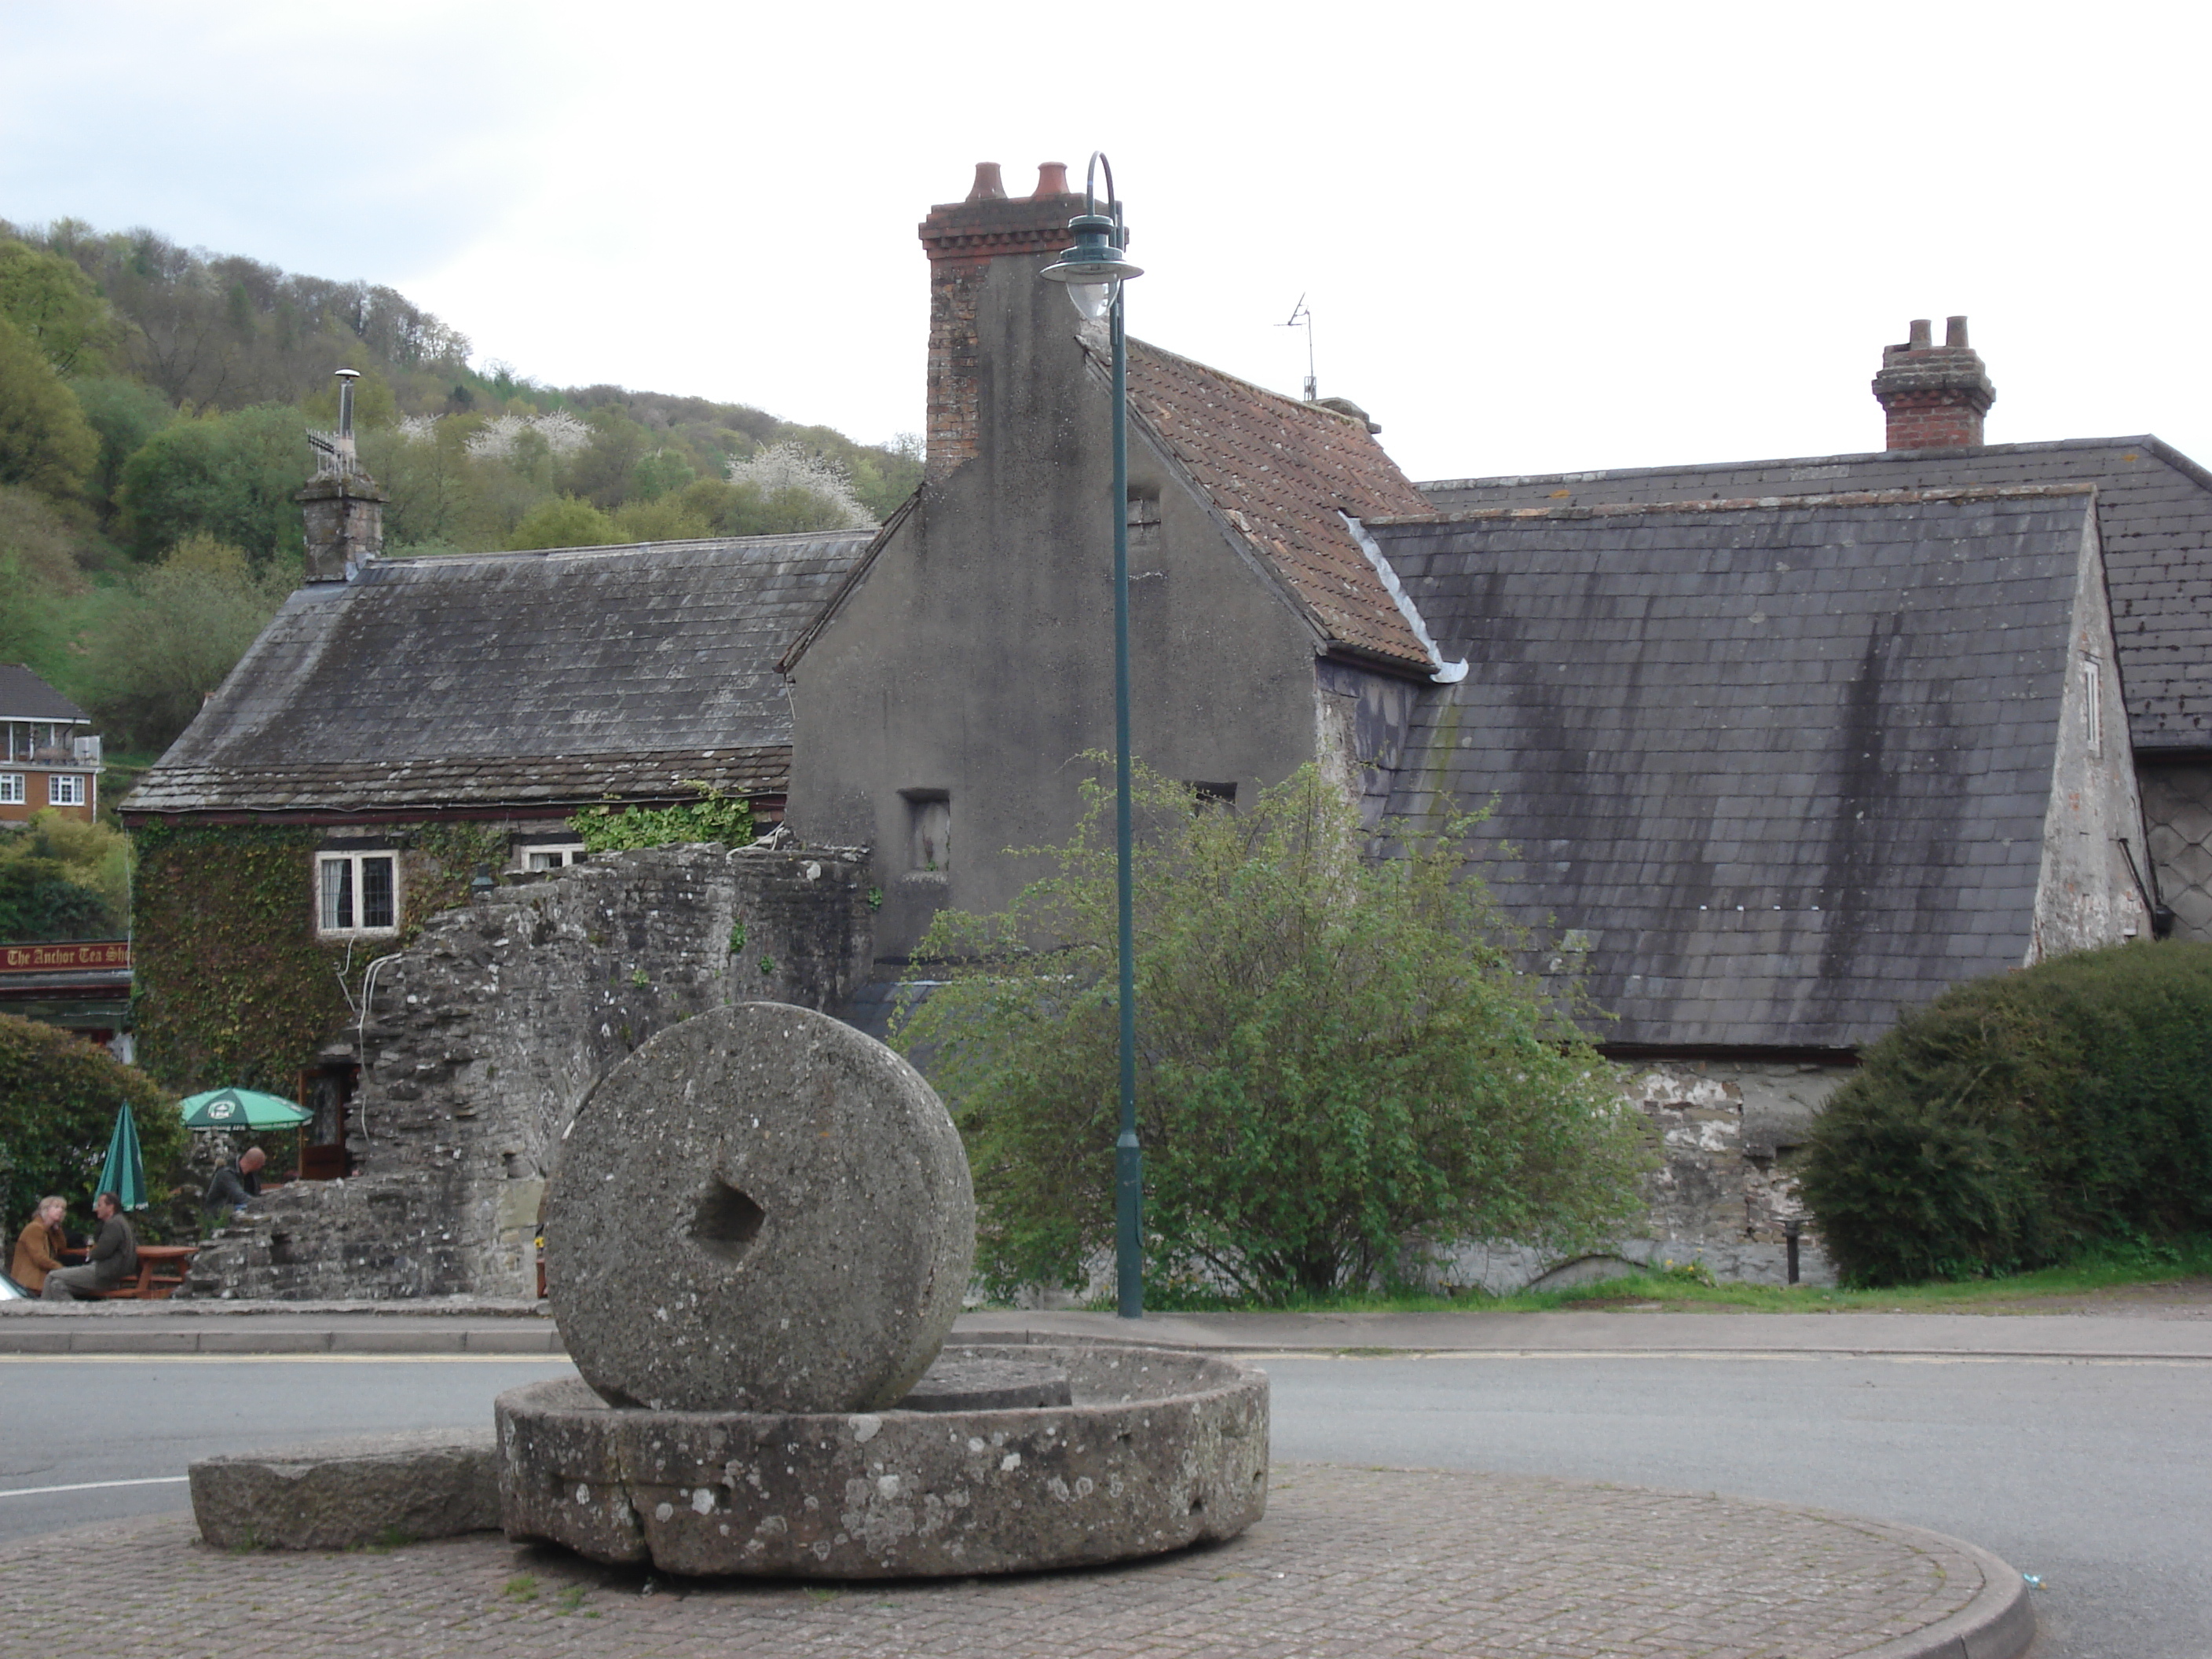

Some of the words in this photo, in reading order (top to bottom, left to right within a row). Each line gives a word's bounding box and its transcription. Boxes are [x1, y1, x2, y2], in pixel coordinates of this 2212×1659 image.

[7, 950, 31, 966] The
[34, 949, 75, 965] Anchor
[79, 947, 102, 963] Tea
